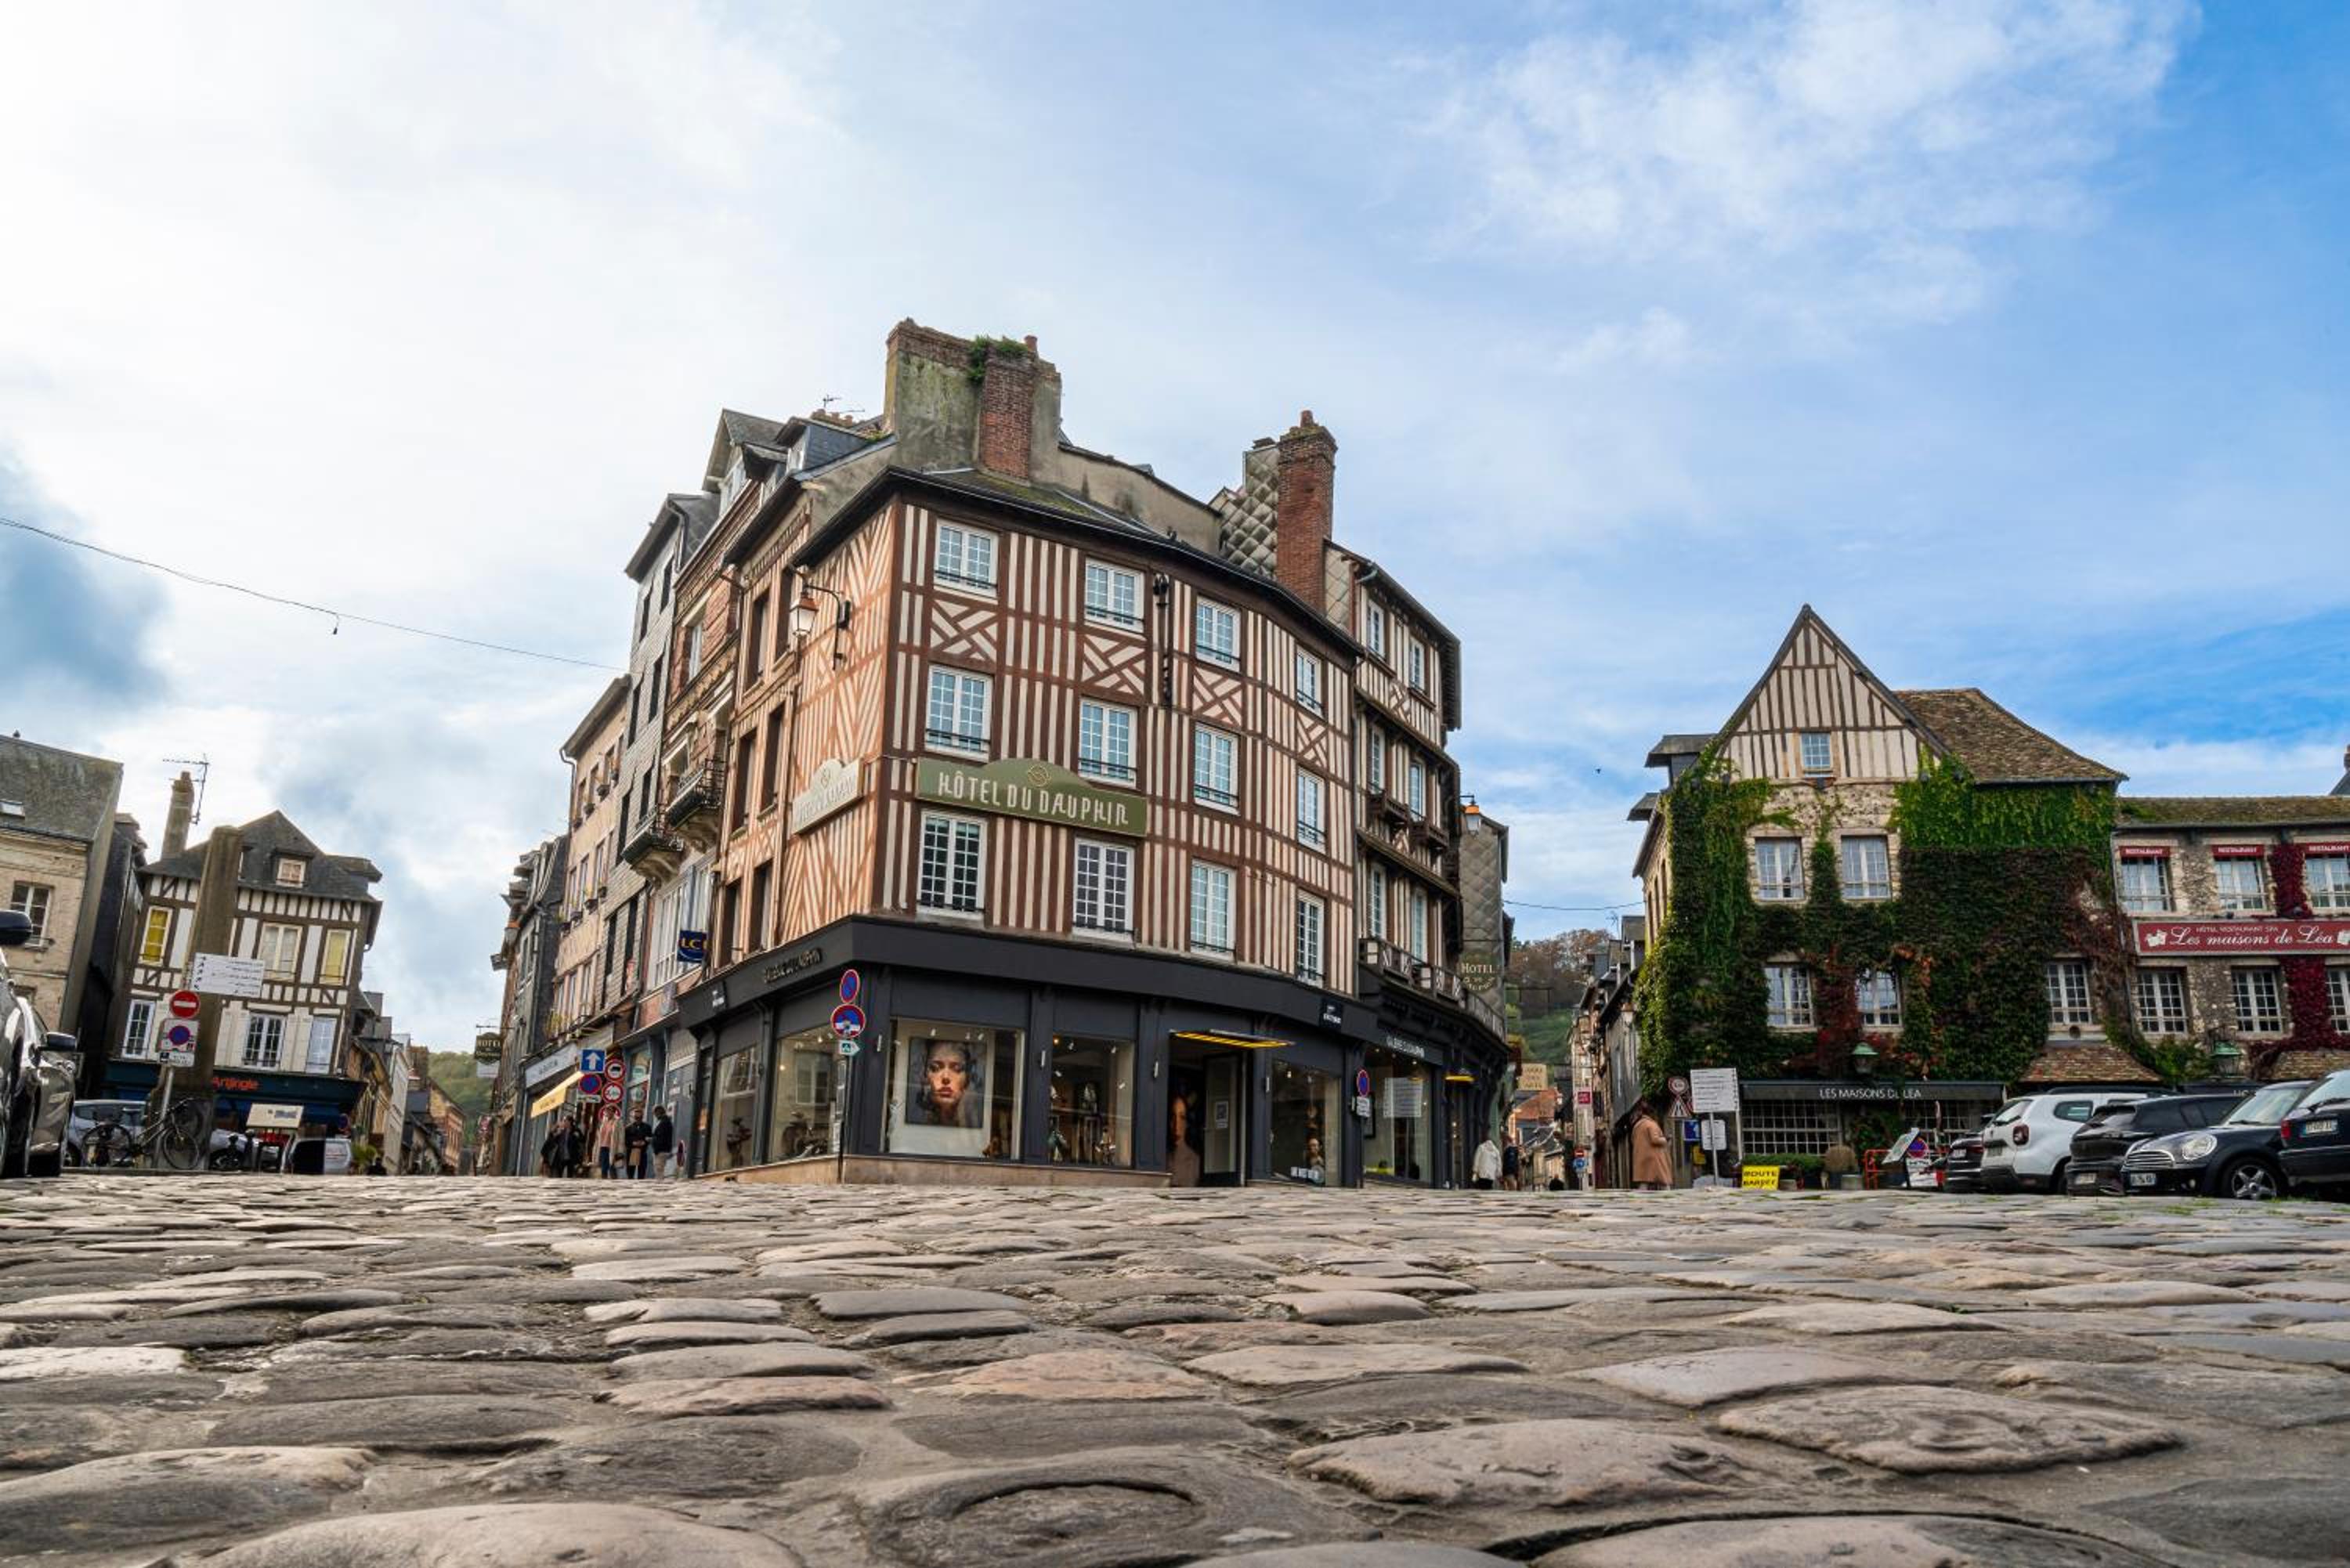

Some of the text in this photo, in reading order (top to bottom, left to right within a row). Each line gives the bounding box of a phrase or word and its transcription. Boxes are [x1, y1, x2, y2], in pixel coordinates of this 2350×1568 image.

[938, 770, 1129, 826] HÔTEL DU DAUPHIN
[2170, 925, 2334, 945] Les maisons de Léa
[1461, 963, 1495, 974] HOTEL
[1820, 1089, 1837, 1099] LES
[1838, 1089, 1885, 1099] MAISONS
